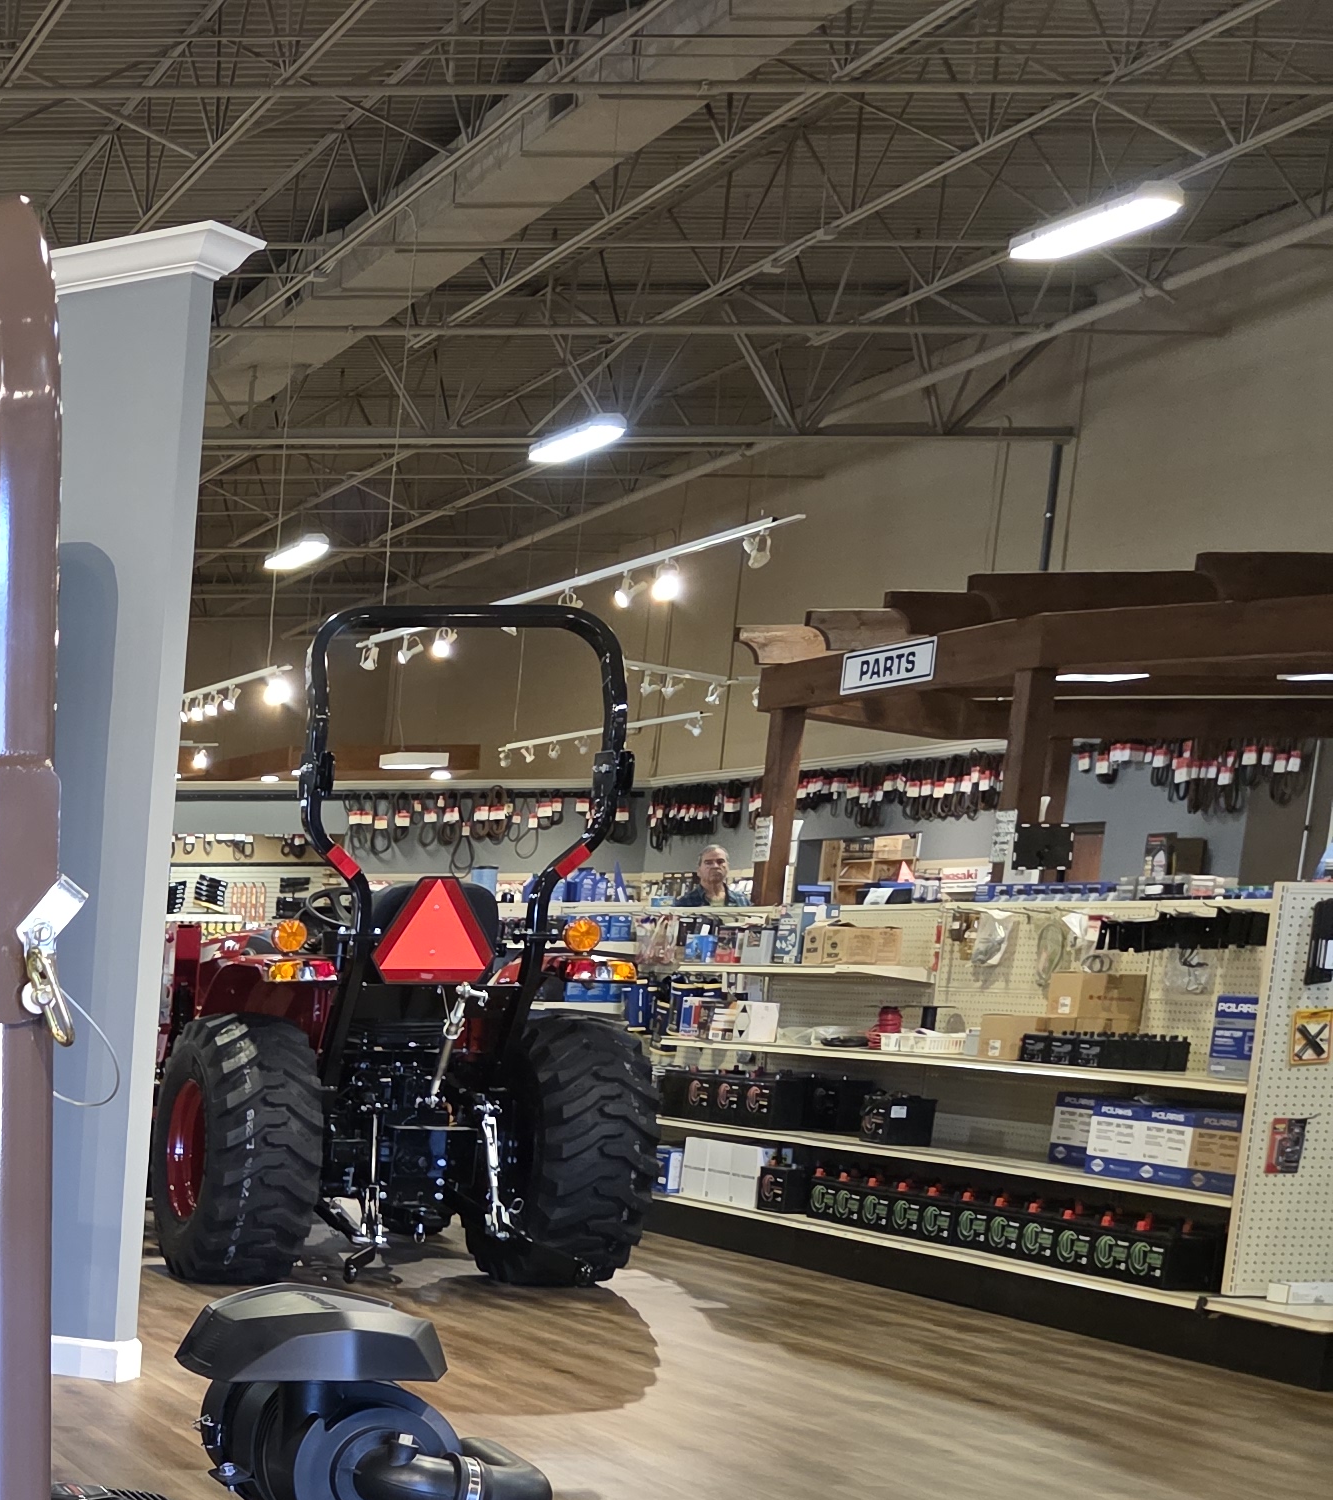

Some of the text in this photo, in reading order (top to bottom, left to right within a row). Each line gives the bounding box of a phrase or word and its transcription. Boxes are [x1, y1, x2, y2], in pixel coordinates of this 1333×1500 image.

[859, 651, 916, 682] PARTS
[1101, 1106, 1132, 1117] POLARIS
[1151, 1111, 1184, 1122] POLARIS
[1203, 1117, 1237, 1128] POLARIS
